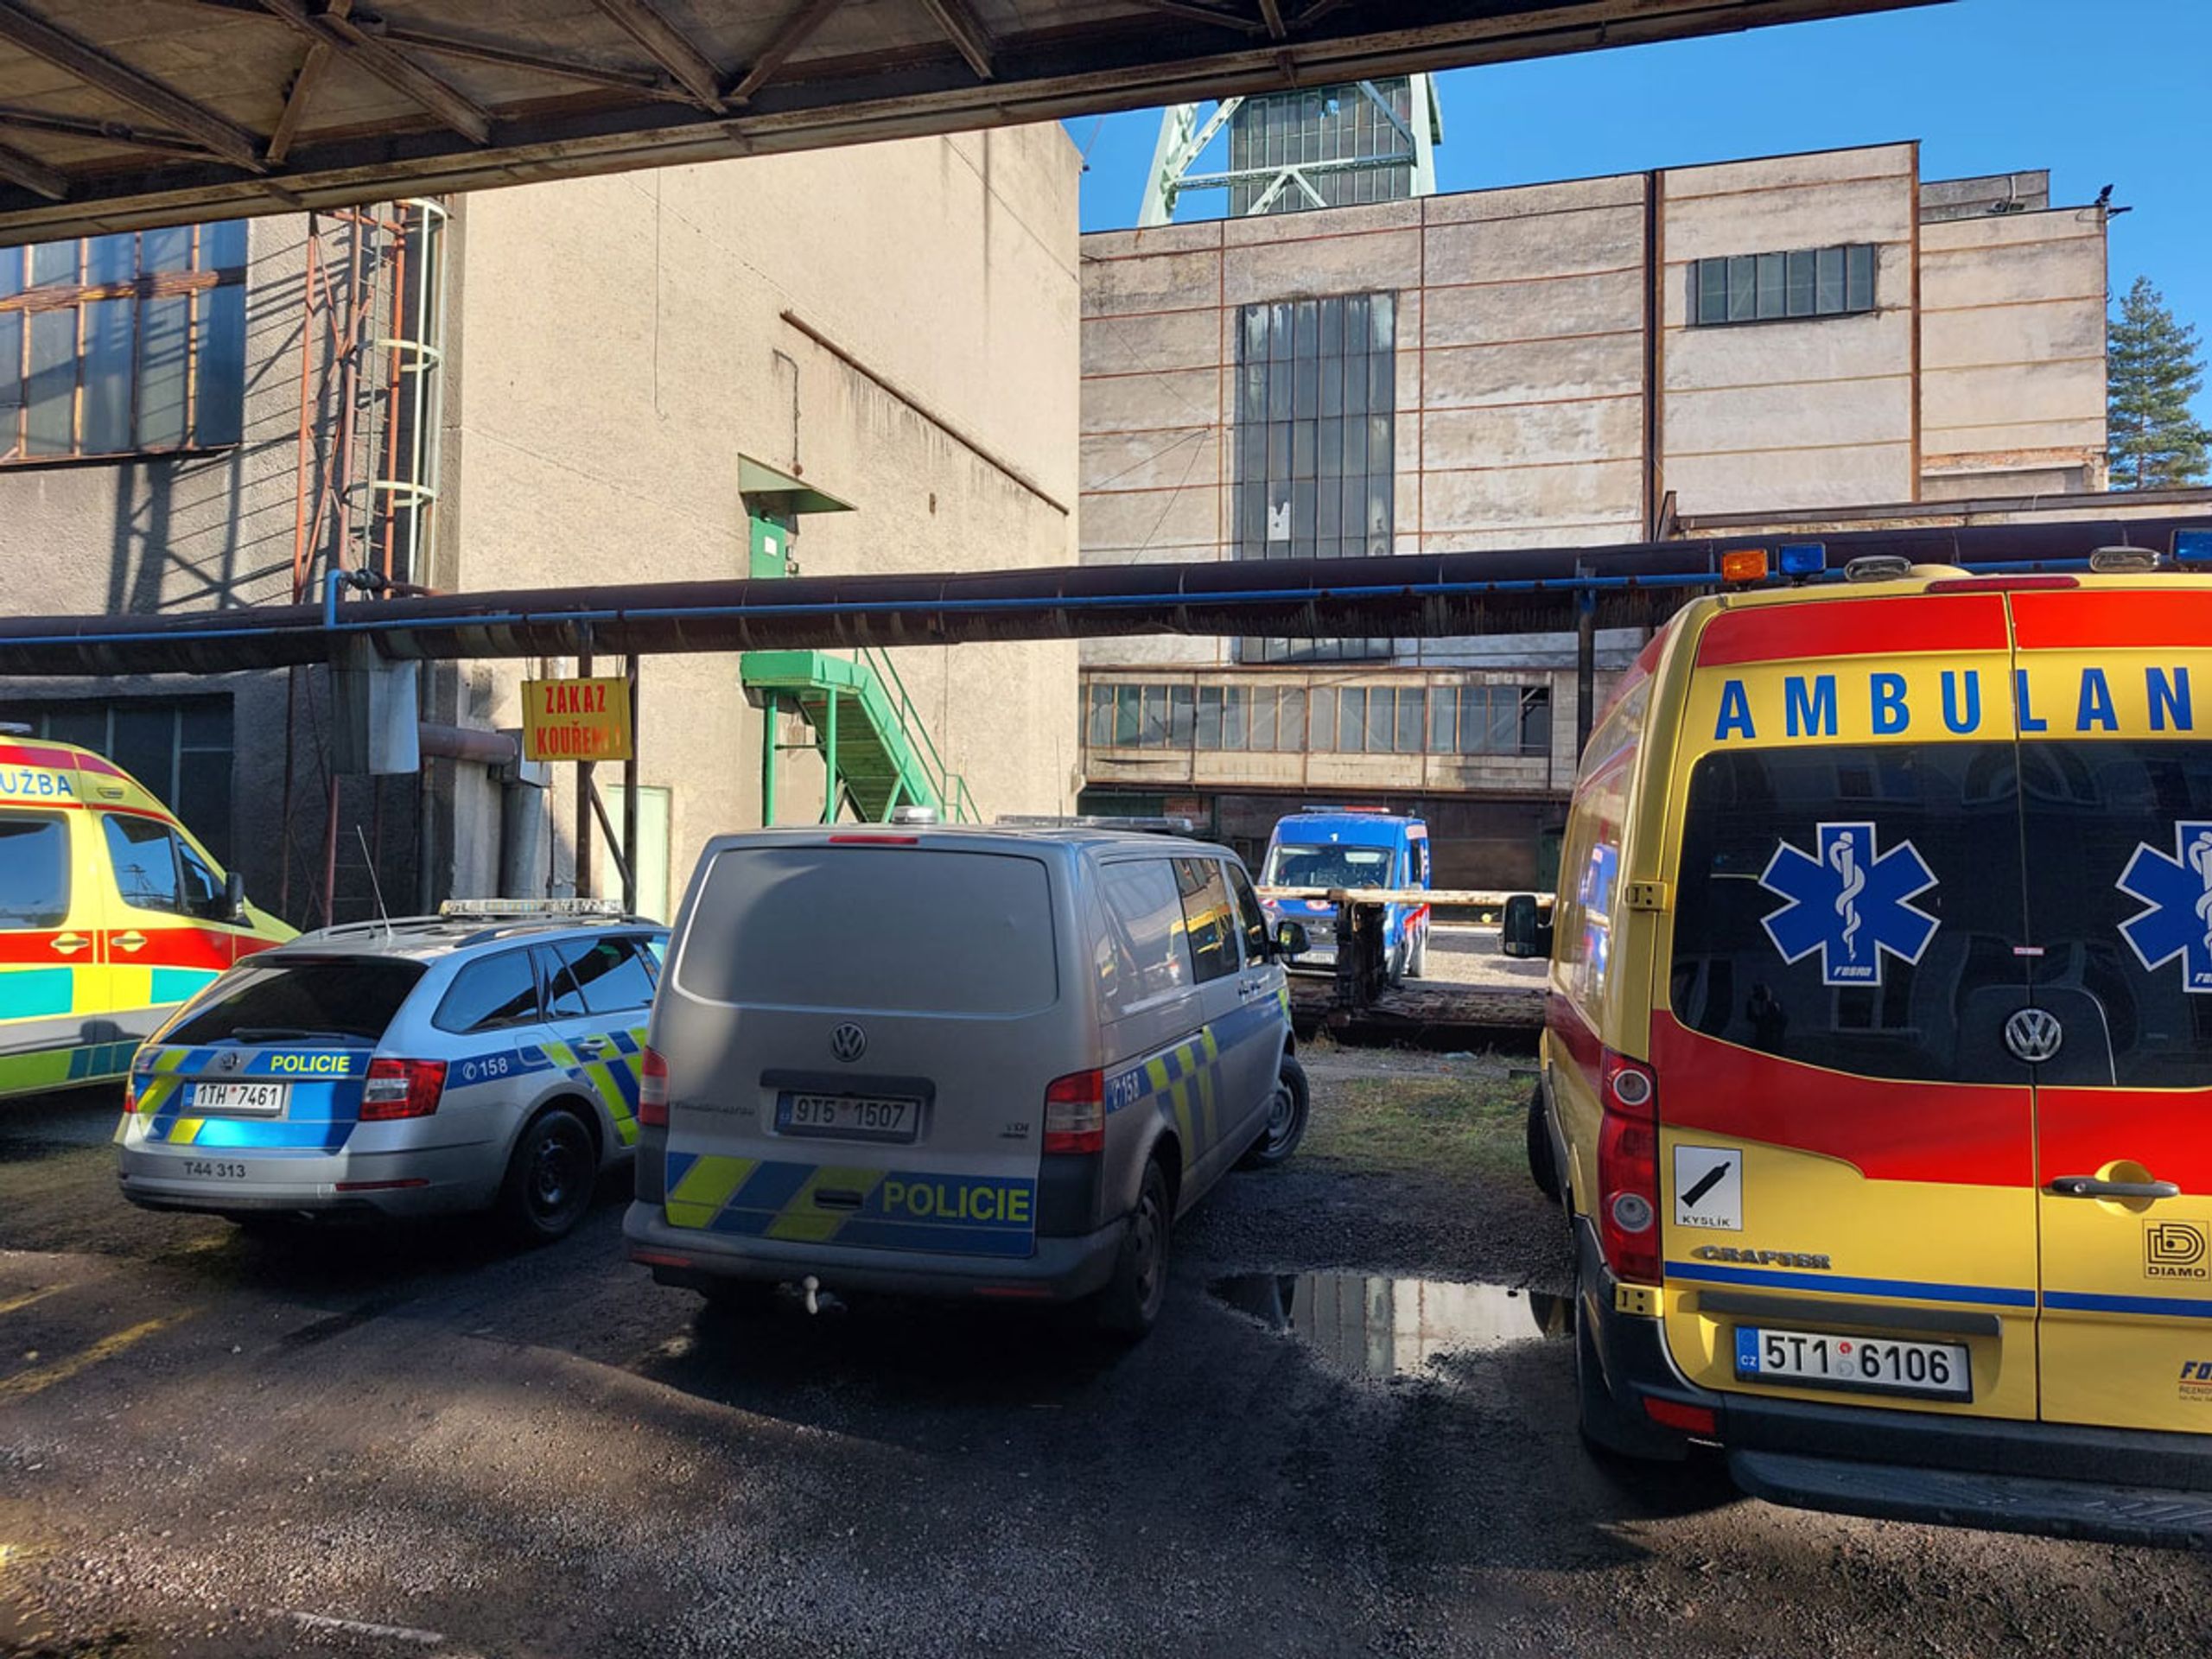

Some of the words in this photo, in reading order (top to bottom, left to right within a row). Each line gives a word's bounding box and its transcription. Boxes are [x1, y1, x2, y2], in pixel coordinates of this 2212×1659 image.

[545, 682, 606, 715] ZÁKAZ
[1714, 667, 2193, 740] AMBULAN
[0, 769, 73, 796] UŽBA
[270, 1055, 351, 1072] POLICIE
[480, 1058, 508, 1077] 158
[199, 1084, 227, 1104] 1TH
[238, 1086, 277, 1105] 7461
[796, 1098, 836, 1123] 9T5
[855, 1102, 905, 1128] 1507
[184, 1161, 213, 1176] T44
[217, 1164, 245, 1177] 313
[883, 1181, 1029, 1222] POLICIE
[1682, 1215, 1730, 1227] KYSLÍK
[2148, 1267, 2206, 1277] DIAMO
[1740, 1355, 1757, 1367] CZ
[1766, 1335, 1828, 1374] 5T1
[1861, 1344, 1949, 1383] 6106
[2181, 1361, 2212, 1380] FO
